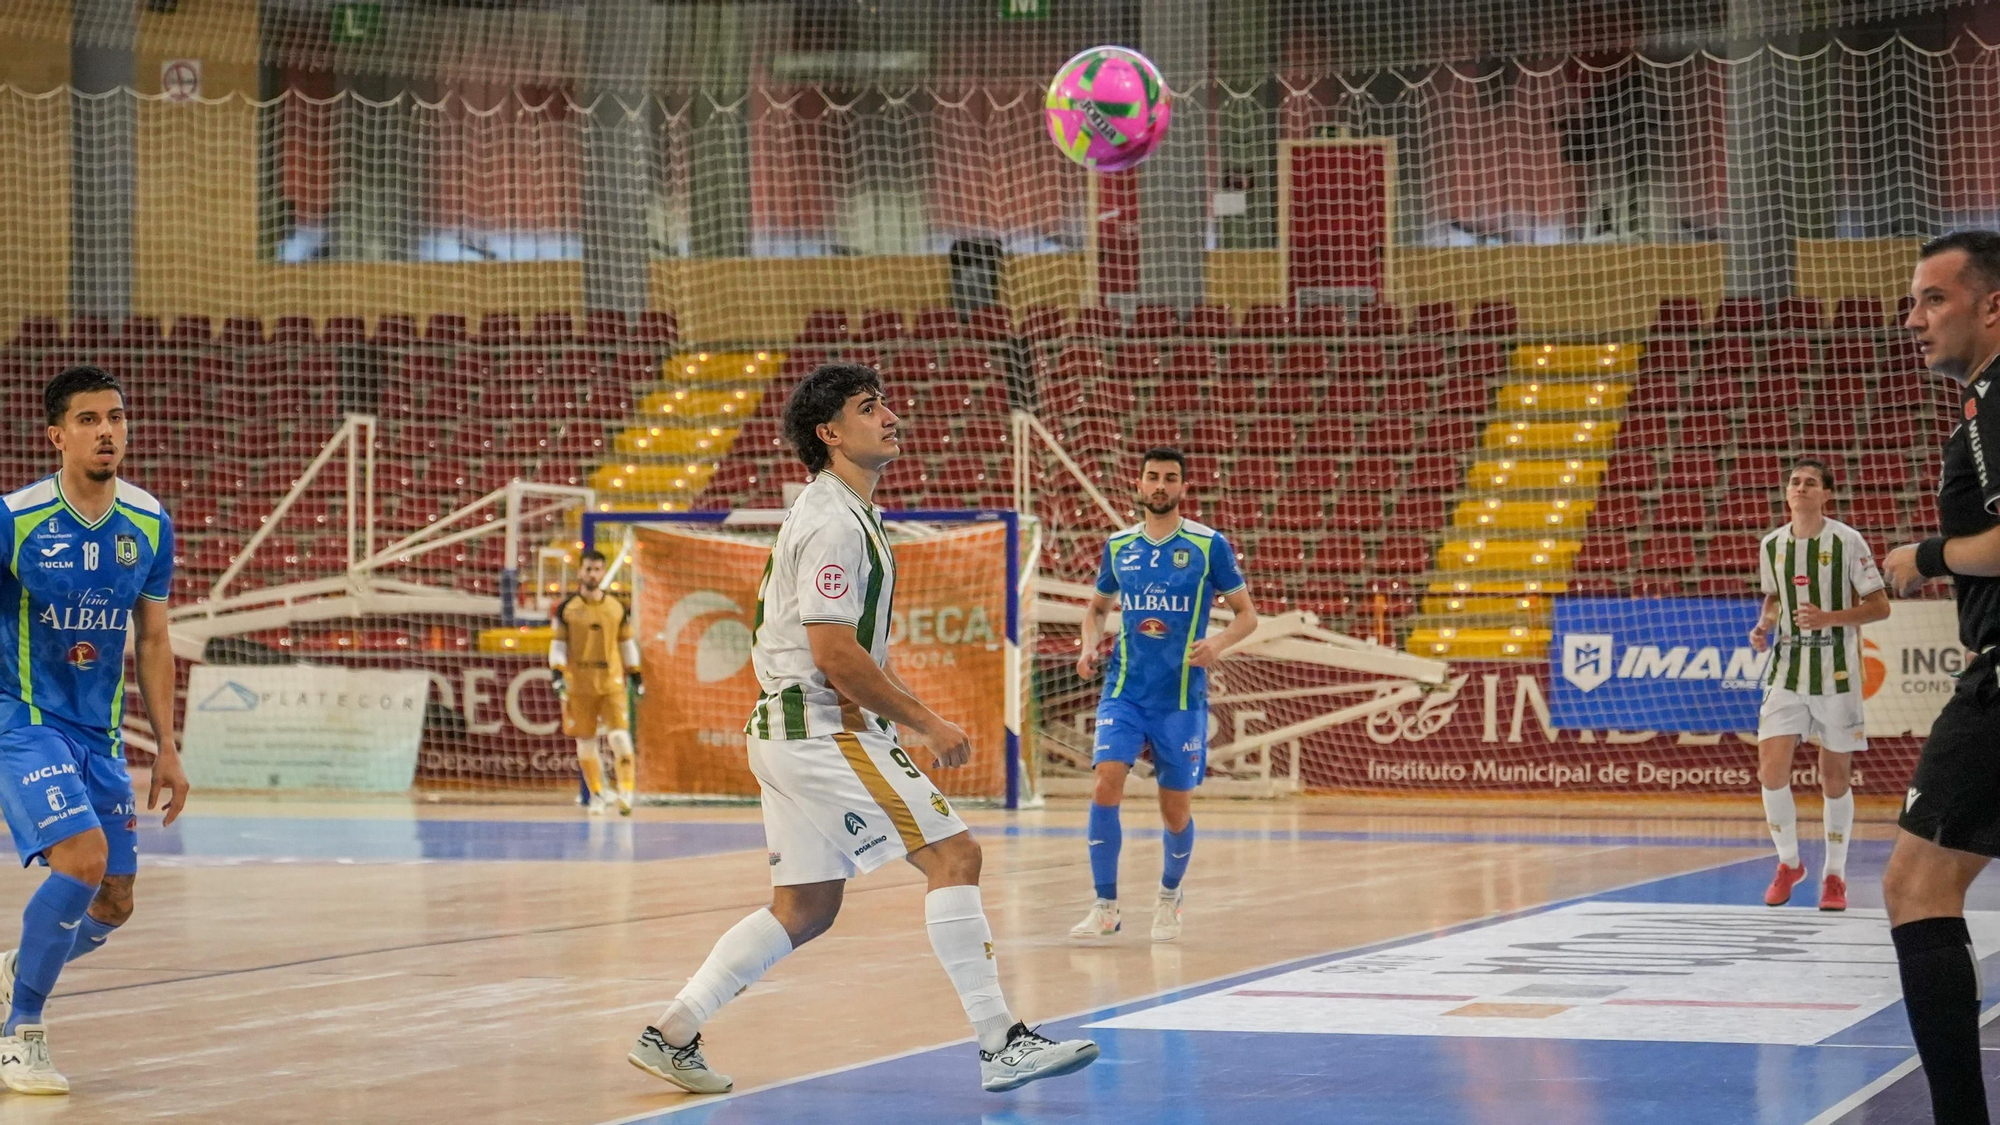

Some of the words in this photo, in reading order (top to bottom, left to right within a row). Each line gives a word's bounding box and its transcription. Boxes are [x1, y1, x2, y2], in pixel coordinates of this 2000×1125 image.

[82, 541, 99, 571] 18
[1150, 549, 1160, 568] 2
[1122, 592, 1190, 612] ALBALI
[40, 603, 132, 631] ALBALI
[1902, 647, 1962, 675] ING
[29, 763, 75, 783] UCLM
[427, 753, 528, 774] Deportes
[890, 748, 921, 779] 9
[1367, 758, 1467, 781] Instituto
[1472, 760, 1591, 787] Municipal
[1598, 762, 1630, 783] de
[1636, 760, 1751, 789] Deportes
